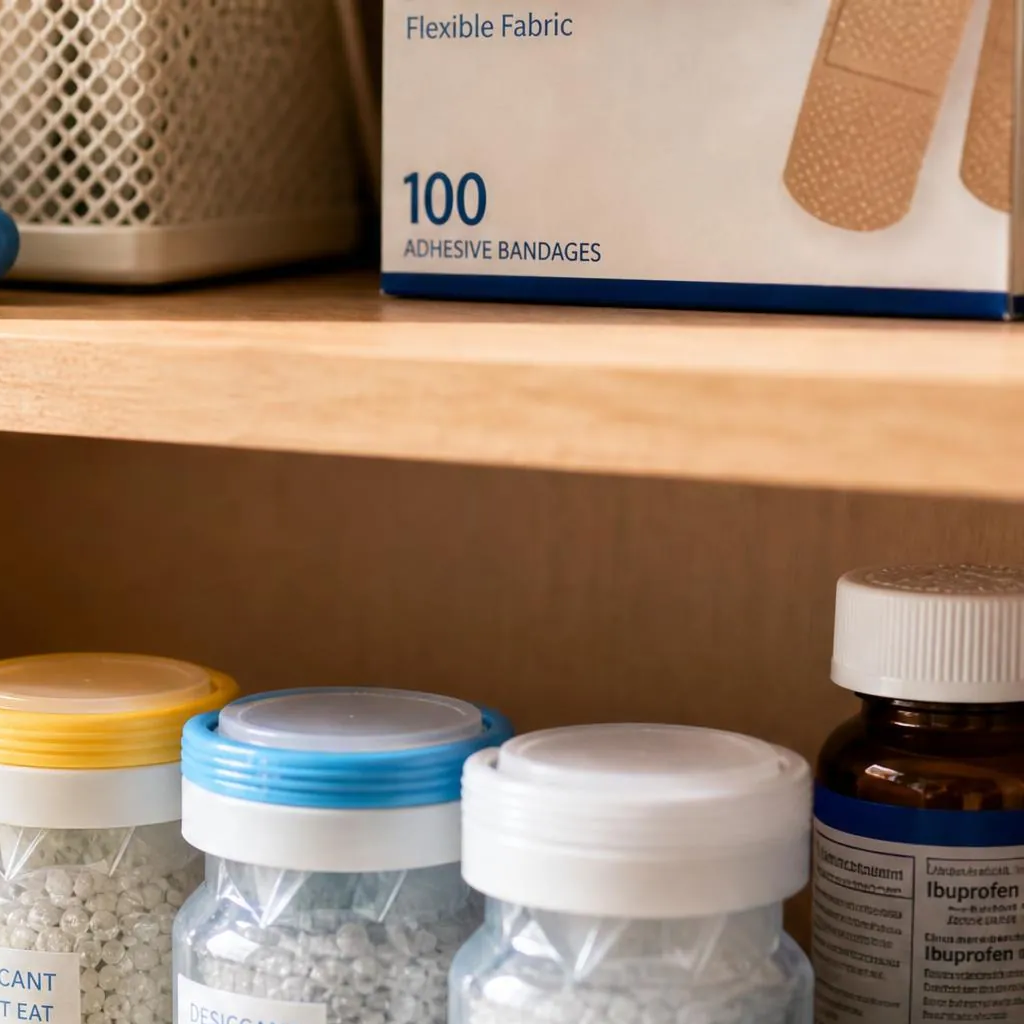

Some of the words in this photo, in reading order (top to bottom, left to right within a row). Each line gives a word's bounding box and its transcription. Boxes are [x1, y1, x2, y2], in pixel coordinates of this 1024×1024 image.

[406, 13, 494, 40] Flexible
[501, 12, 573, 37] Fabric
[403, 171, 487, 226] 100
[403, 239, 492, 260] ADHESIVE
[498, 240, 602, 262] BANDAGES
[927, 881, 1019, 903] Ibuprofen
[925, 946, 1013, 966] Ibuprofen
[17, 1002, 54, 1022] EAT
